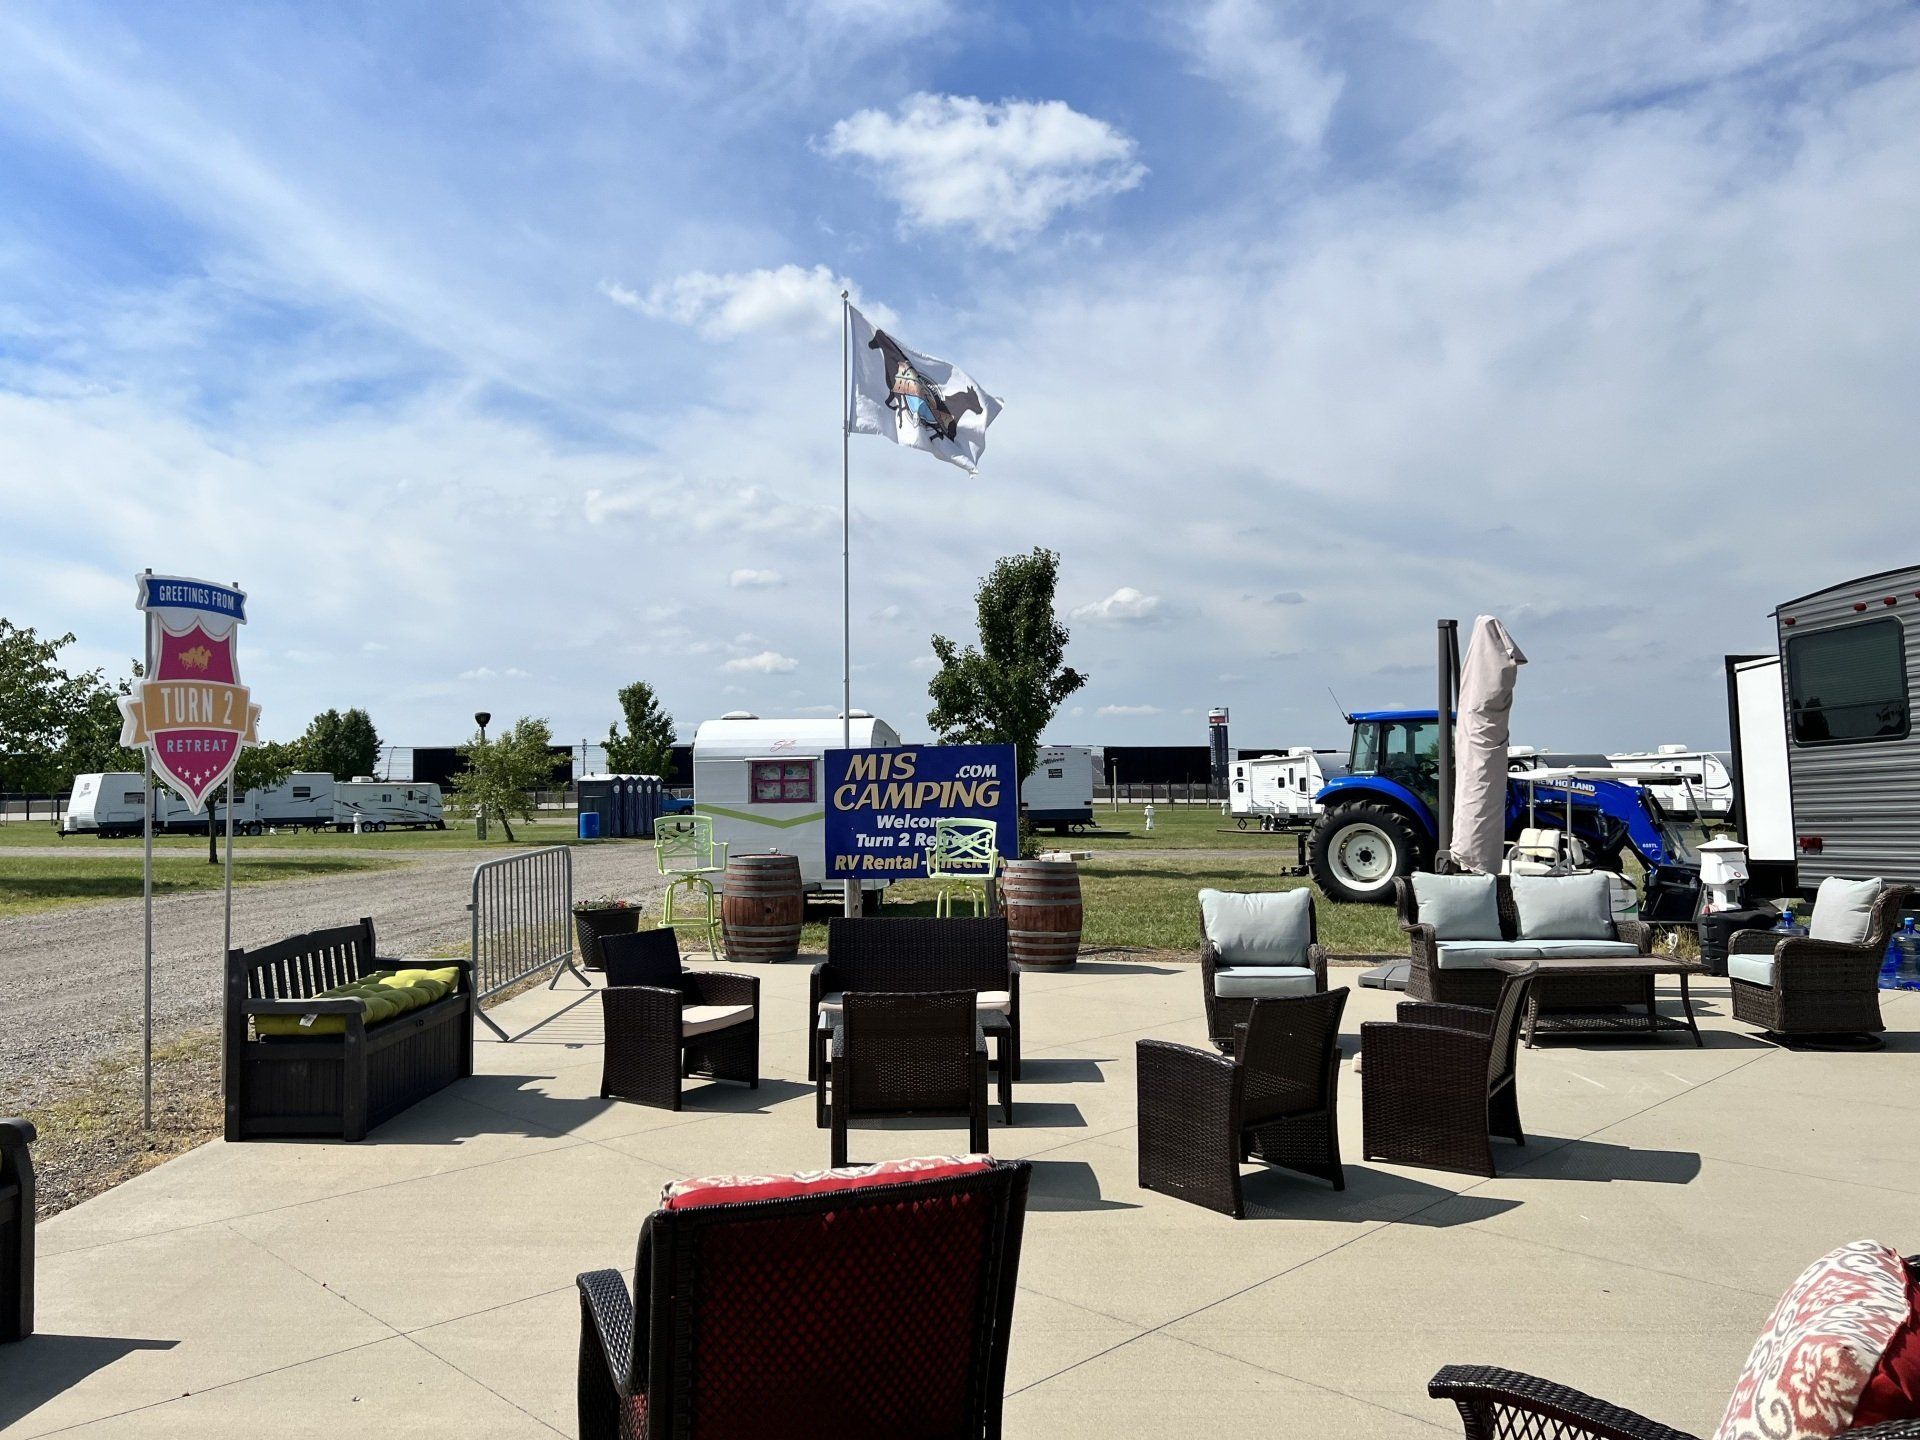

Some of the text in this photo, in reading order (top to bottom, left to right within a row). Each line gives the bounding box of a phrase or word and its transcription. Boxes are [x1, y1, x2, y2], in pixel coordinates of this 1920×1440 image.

[160, 585, 234, 610] GREETINGS FROM
[160, 687, 233, 724] TURN 2
[167, 739, 228, 752] RETREAT
[844, 752, 917, 781] MIS
[955, 764, 997, 778] .COM
[1555, 780, 1595, 791] HOLAND
[833, 780, 1001, 811] CAMPING
[876, 813, 955, 829] Welcom
[856, 833, 894, 847] Turn
[898, 832, 910, 846] 2
[835, 854, 860, 870] RV
[862, 853, 919, 870] Rental
